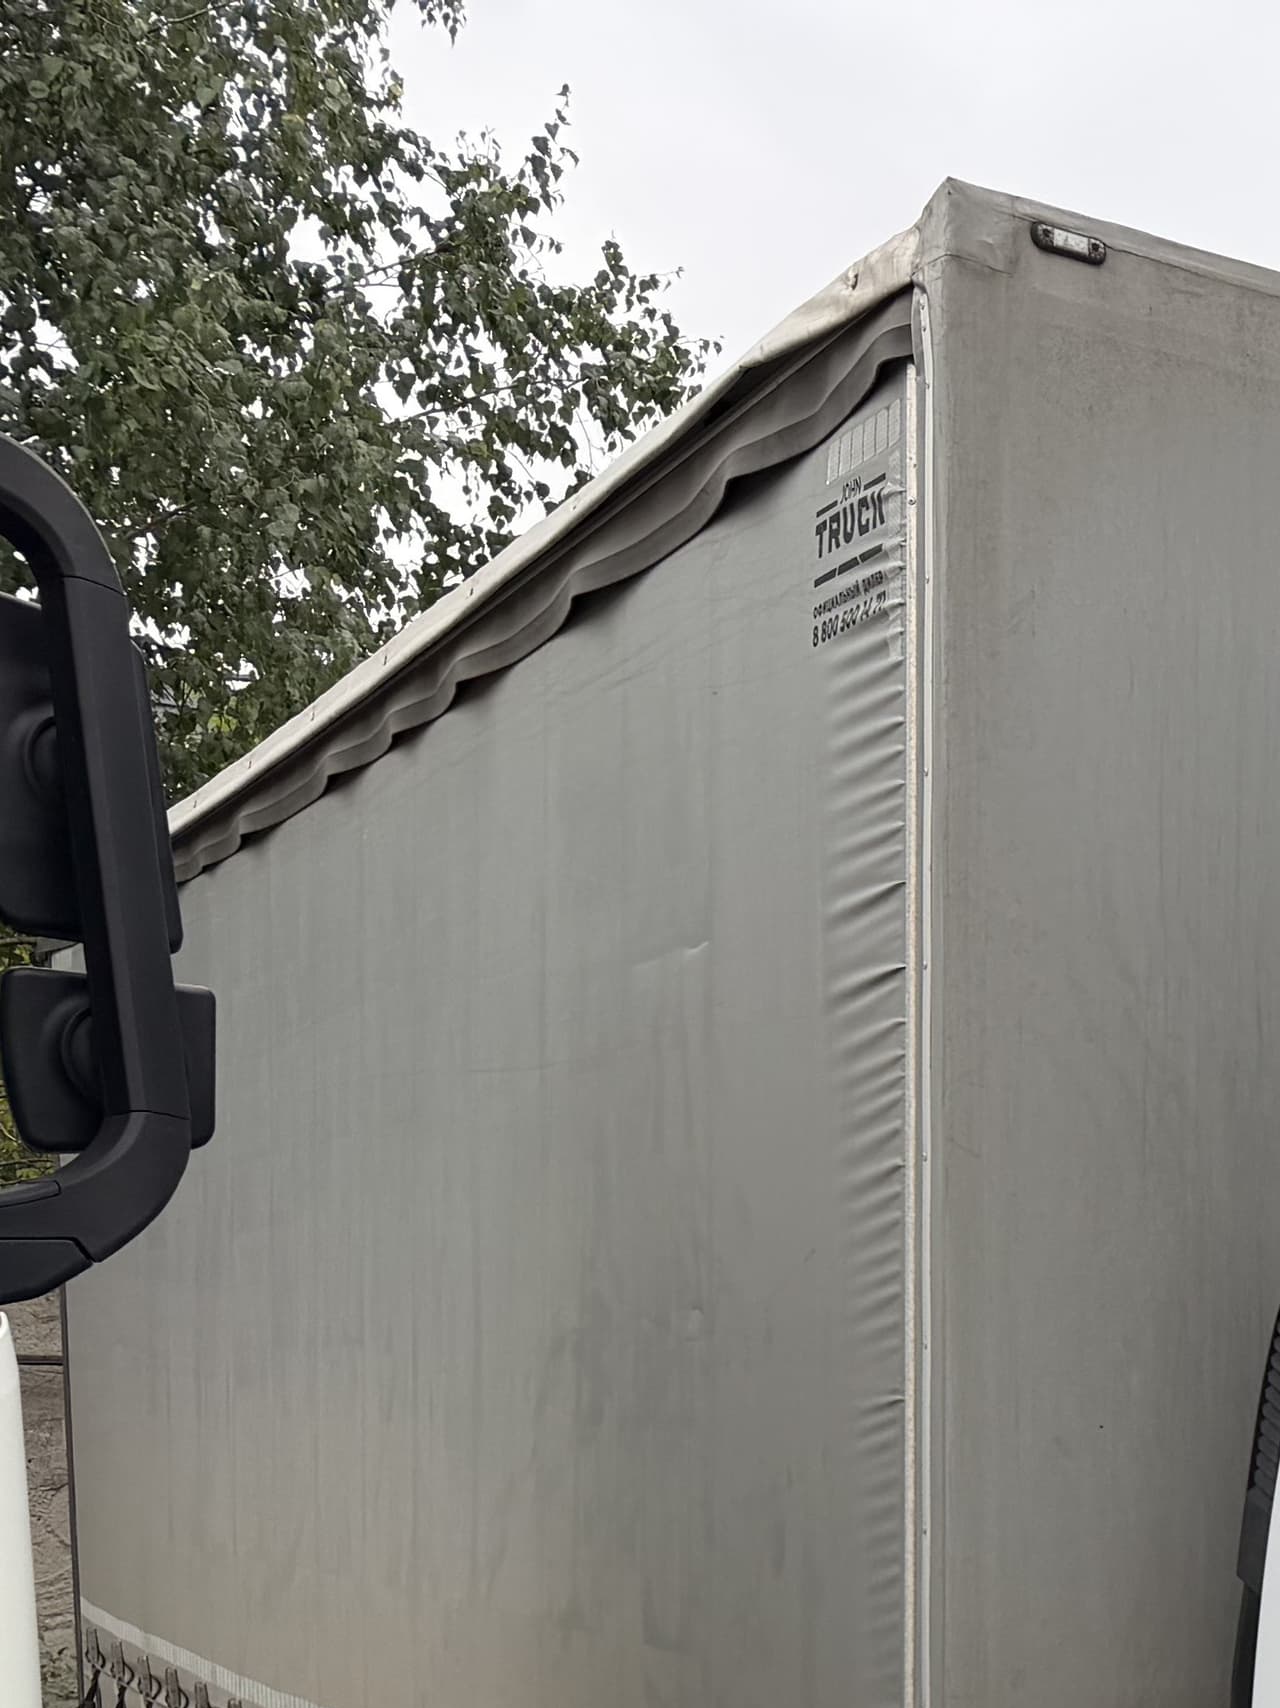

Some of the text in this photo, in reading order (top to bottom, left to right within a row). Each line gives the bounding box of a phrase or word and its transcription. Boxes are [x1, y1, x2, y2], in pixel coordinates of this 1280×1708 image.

[840, 476, 862, 505] JOHN
[815, 487, 886, 559] TRUCK
[812, 625, 819, 648] 8
[821, 614, 840, 643] 800
[840, 604, 860, 632] 500
